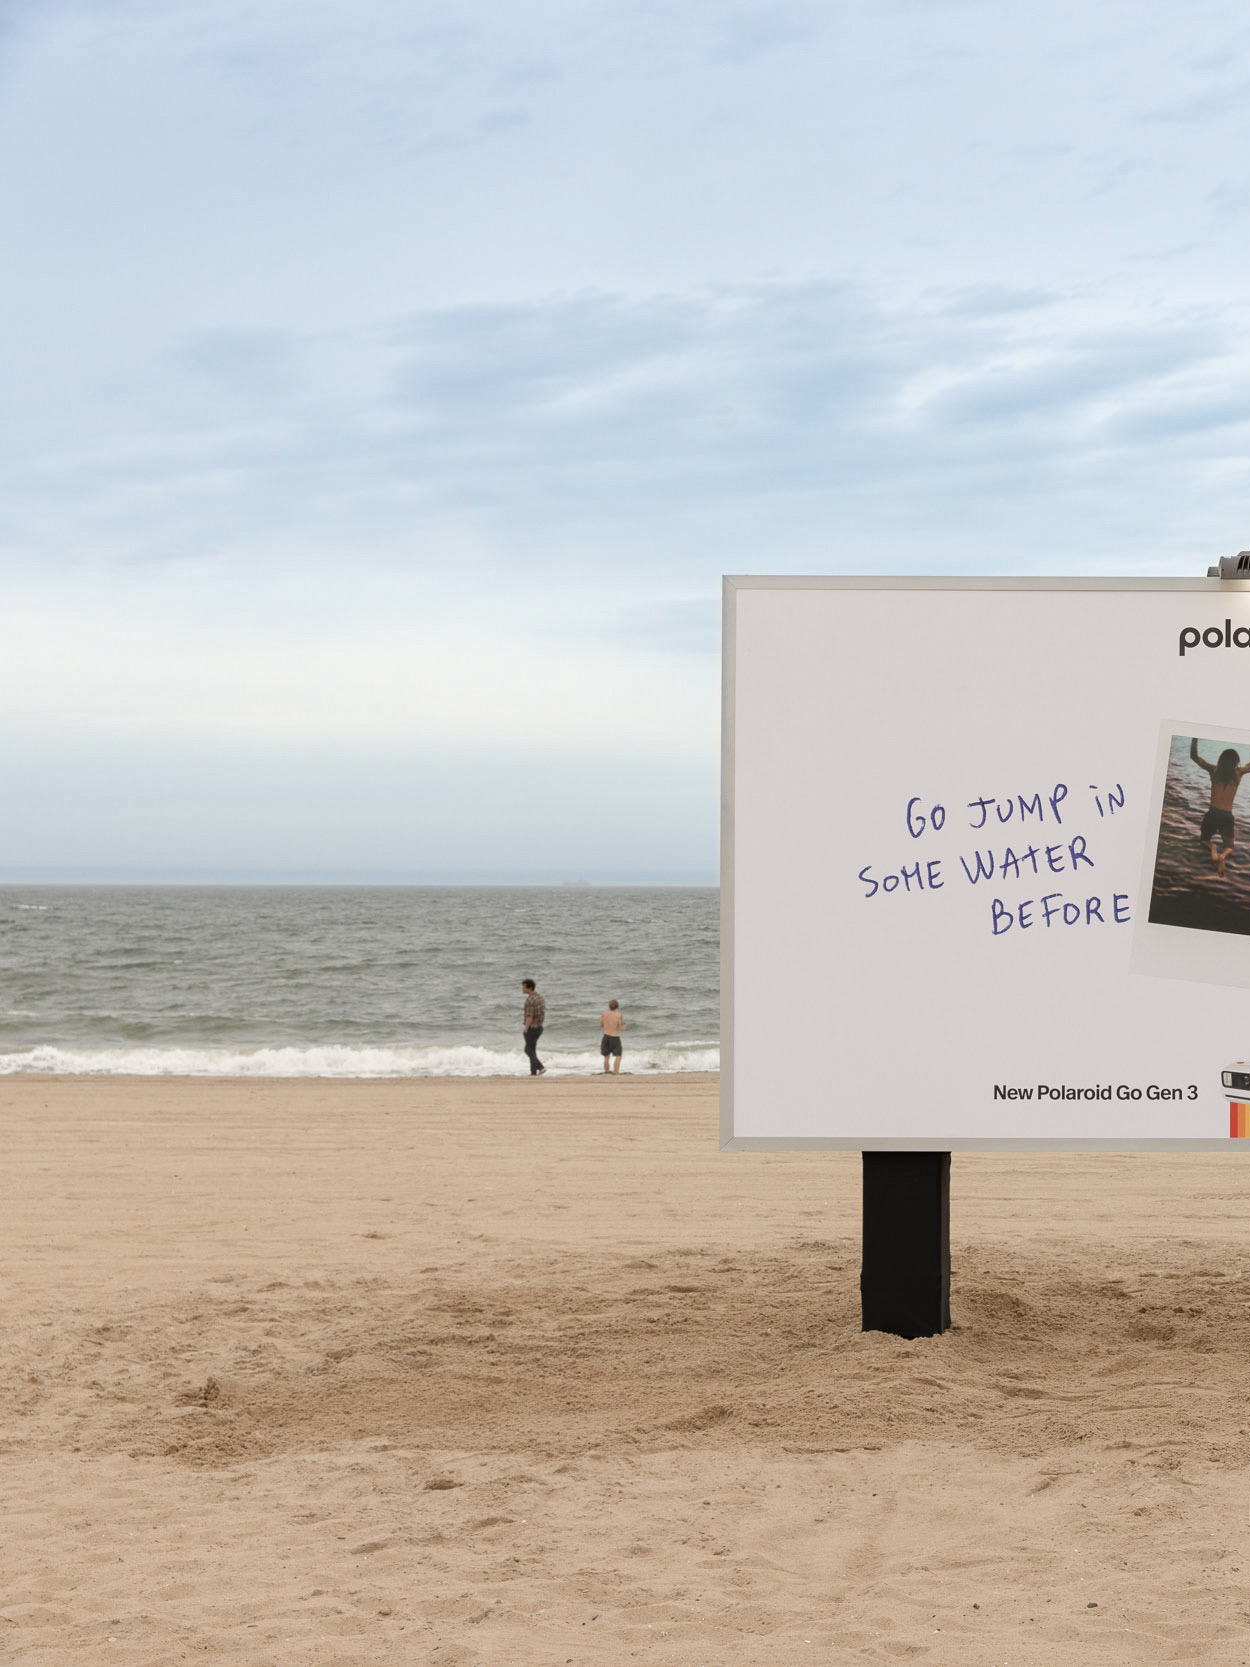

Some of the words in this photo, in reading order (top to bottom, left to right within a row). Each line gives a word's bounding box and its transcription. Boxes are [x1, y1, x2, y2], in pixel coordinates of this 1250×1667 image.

[906, 796, 946, 839] GO
[967, 783, 1069, 829] JUMP
[858, 860, 945, 899] SOME
[959, 835, 1095, 885] WATER
[991, 892, 1132, 936] BEFORE
[993, 1084, 1034, 1101] New
[1037, 1083, 1113, 1101] Polaroid
[1115, 1084, 1143, 1101] Go
[1145, 1084, 1183, 1101] Gen
[1186, 1084, 1199, 1101] 3
